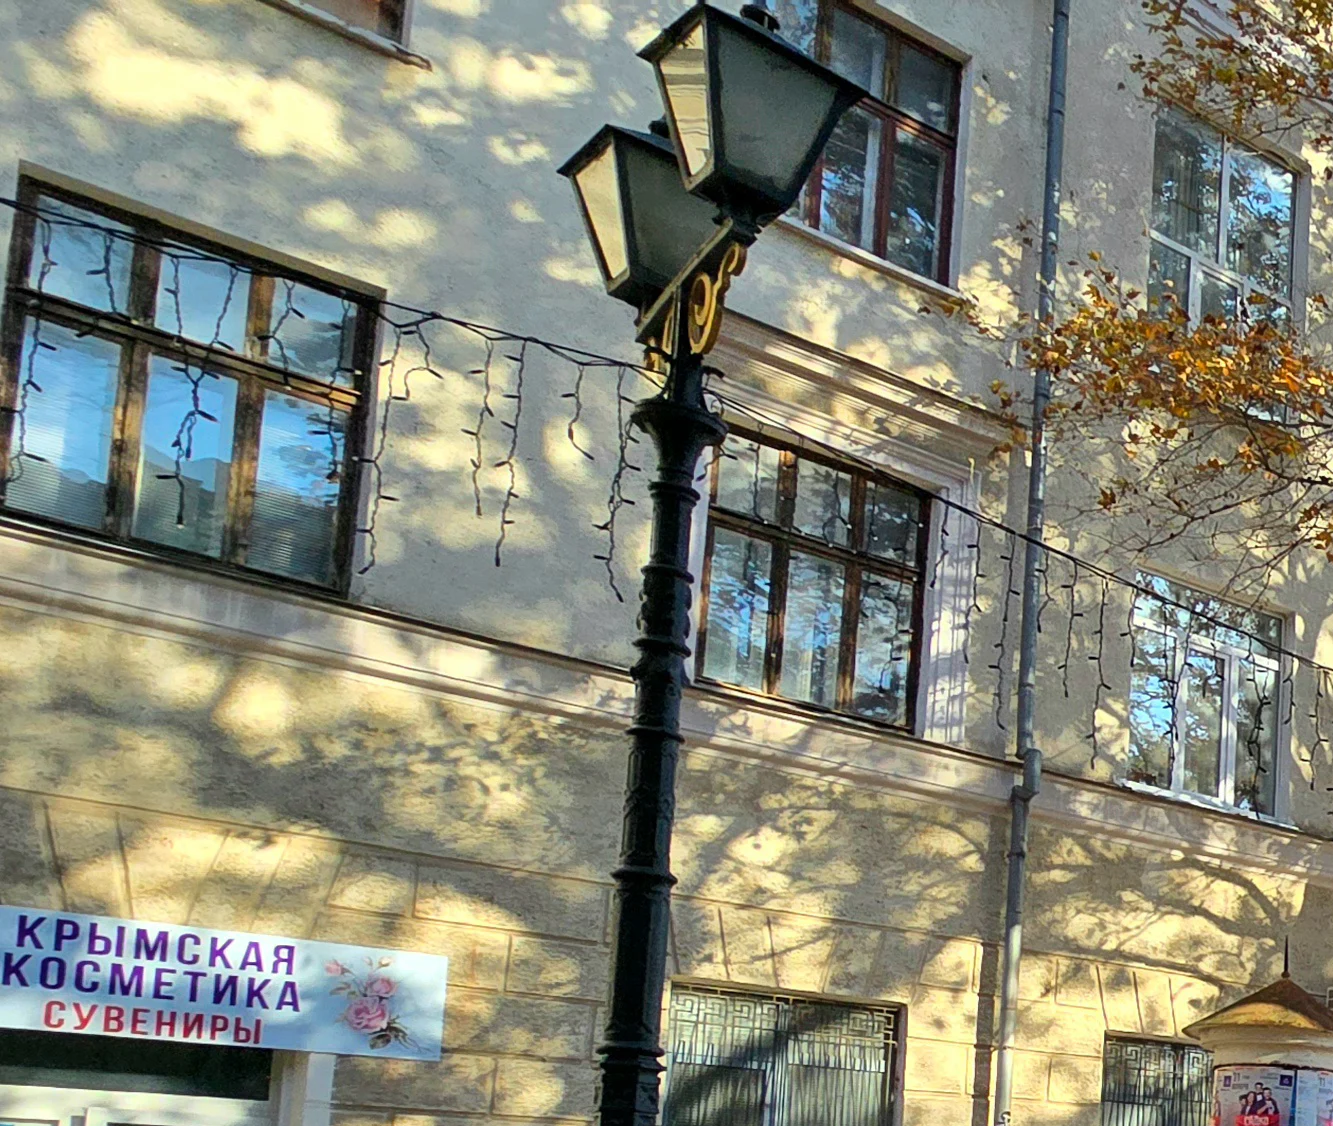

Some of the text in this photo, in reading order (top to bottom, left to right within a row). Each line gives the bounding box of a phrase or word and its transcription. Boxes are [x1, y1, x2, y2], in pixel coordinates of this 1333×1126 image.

[16, 914, 297, 975] КРЫМСКАЯ
[1, 952, 302, 1012] КОСМЕТИКА
[43, 1000, 263, 1045] СУВЕНИРЫ
